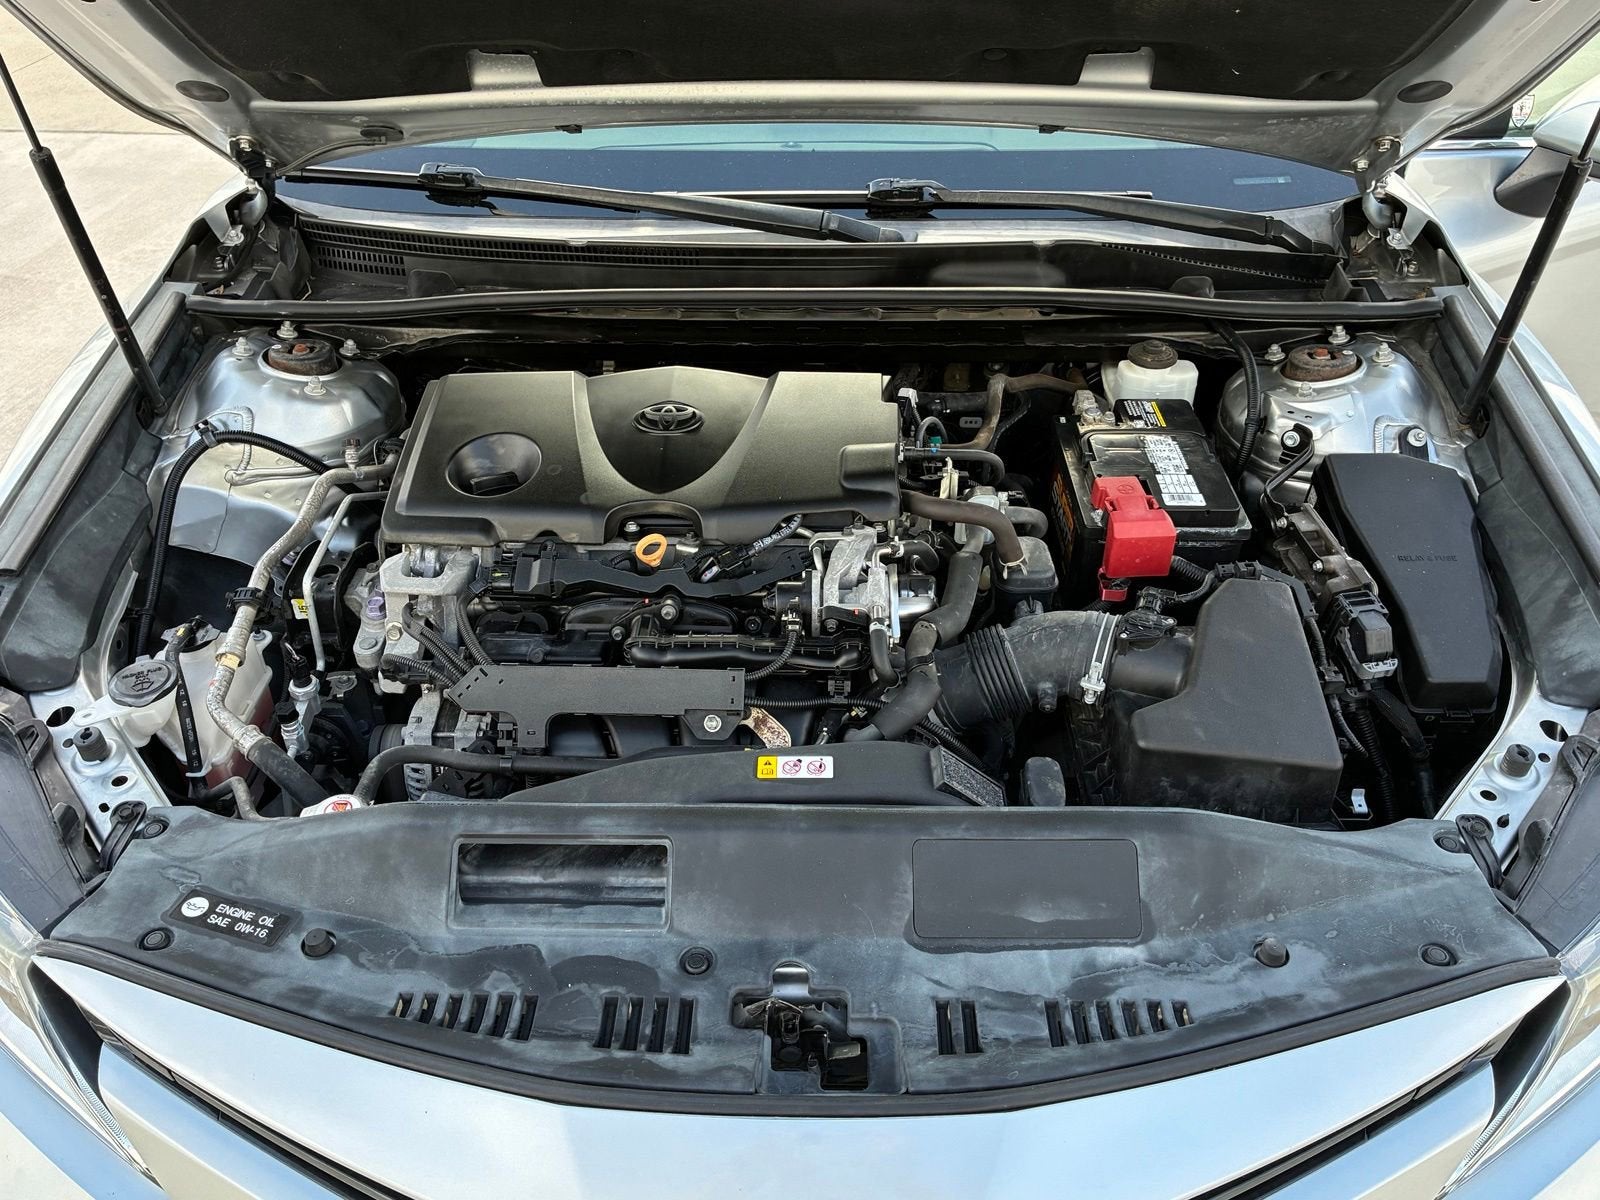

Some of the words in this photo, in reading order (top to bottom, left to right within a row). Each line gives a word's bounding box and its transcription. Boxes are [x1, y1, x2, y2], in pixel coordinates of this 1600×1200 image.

[1397, 554, 1425, 562] RELAY
[1434, 554, 1458, 562] FUSE
[207, 914, 232, 928] SAE
[234, 922, 269, 938] 0W-16
[215, 903, 256, 921] ENGINE
[258, 915, 275, 927] OIL
